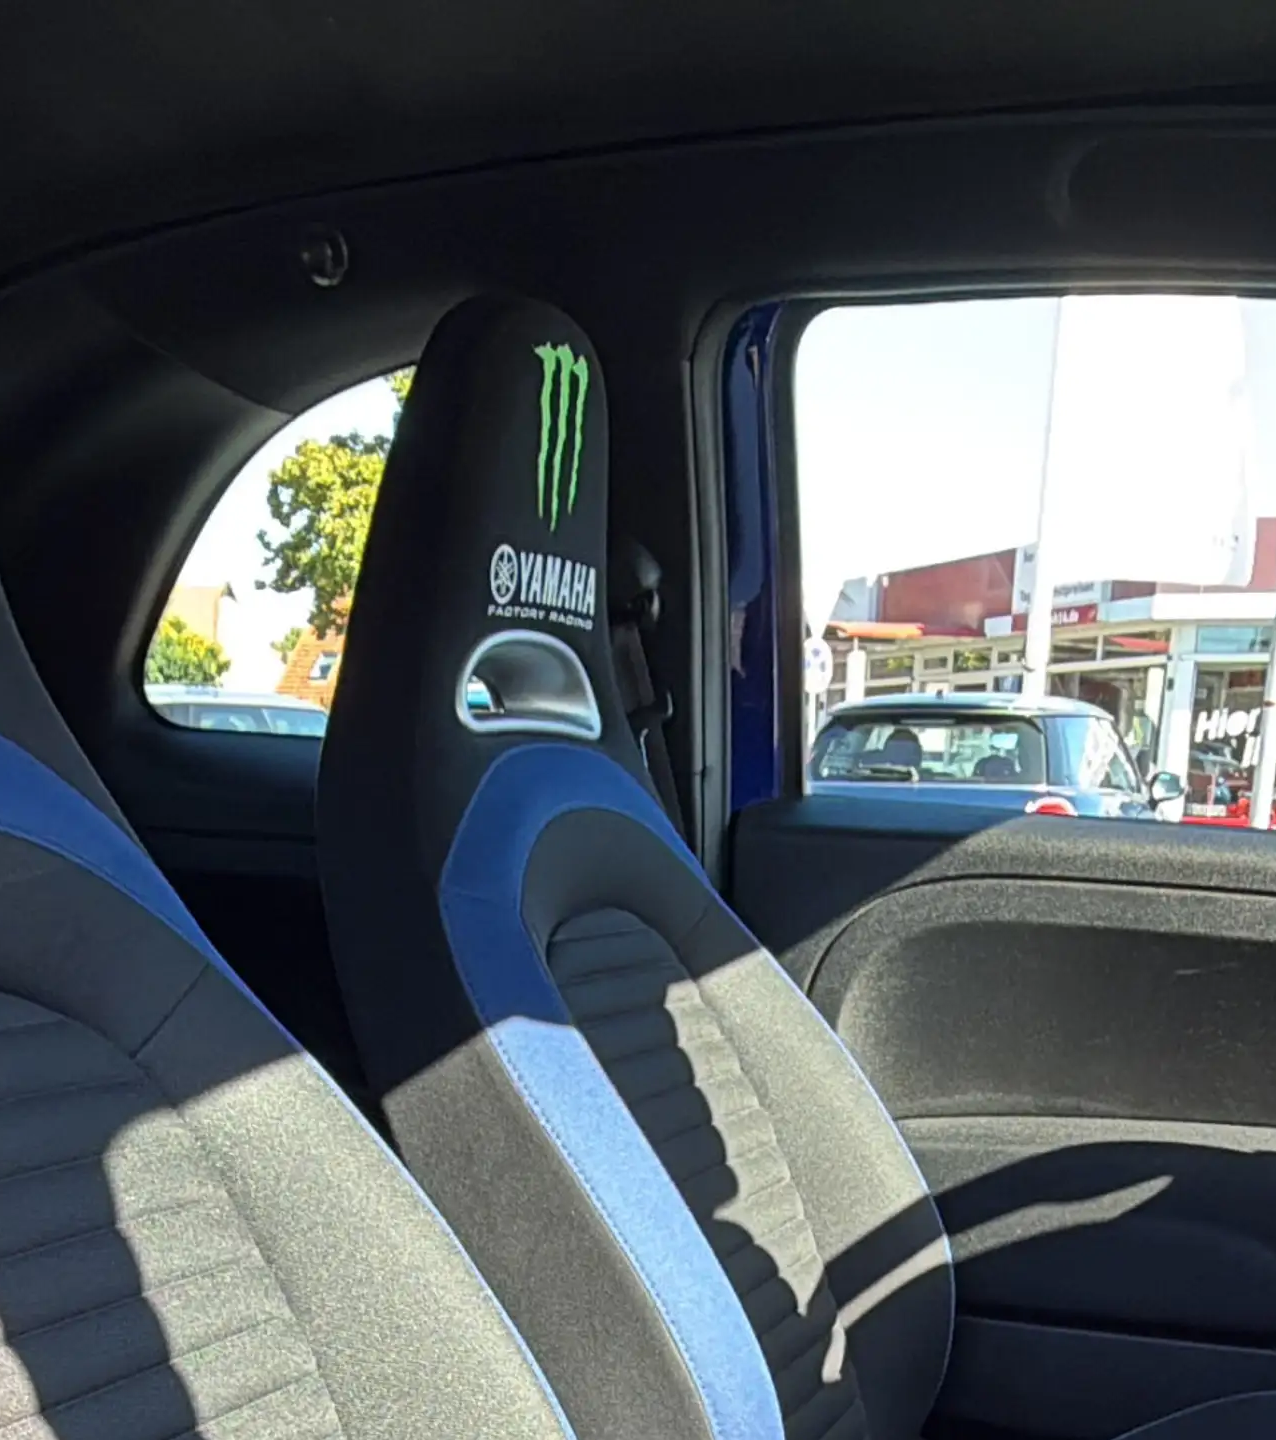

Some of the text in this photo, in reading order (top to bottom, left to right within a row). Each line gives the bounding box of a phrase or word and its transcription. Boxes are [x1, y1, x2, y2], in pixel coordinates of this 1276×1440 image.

[520, 551, 597, 617] YAMAHA
[487, 603, 594, 631] FACTORY RACING
[1194, 706, 1261, 744] Hier
